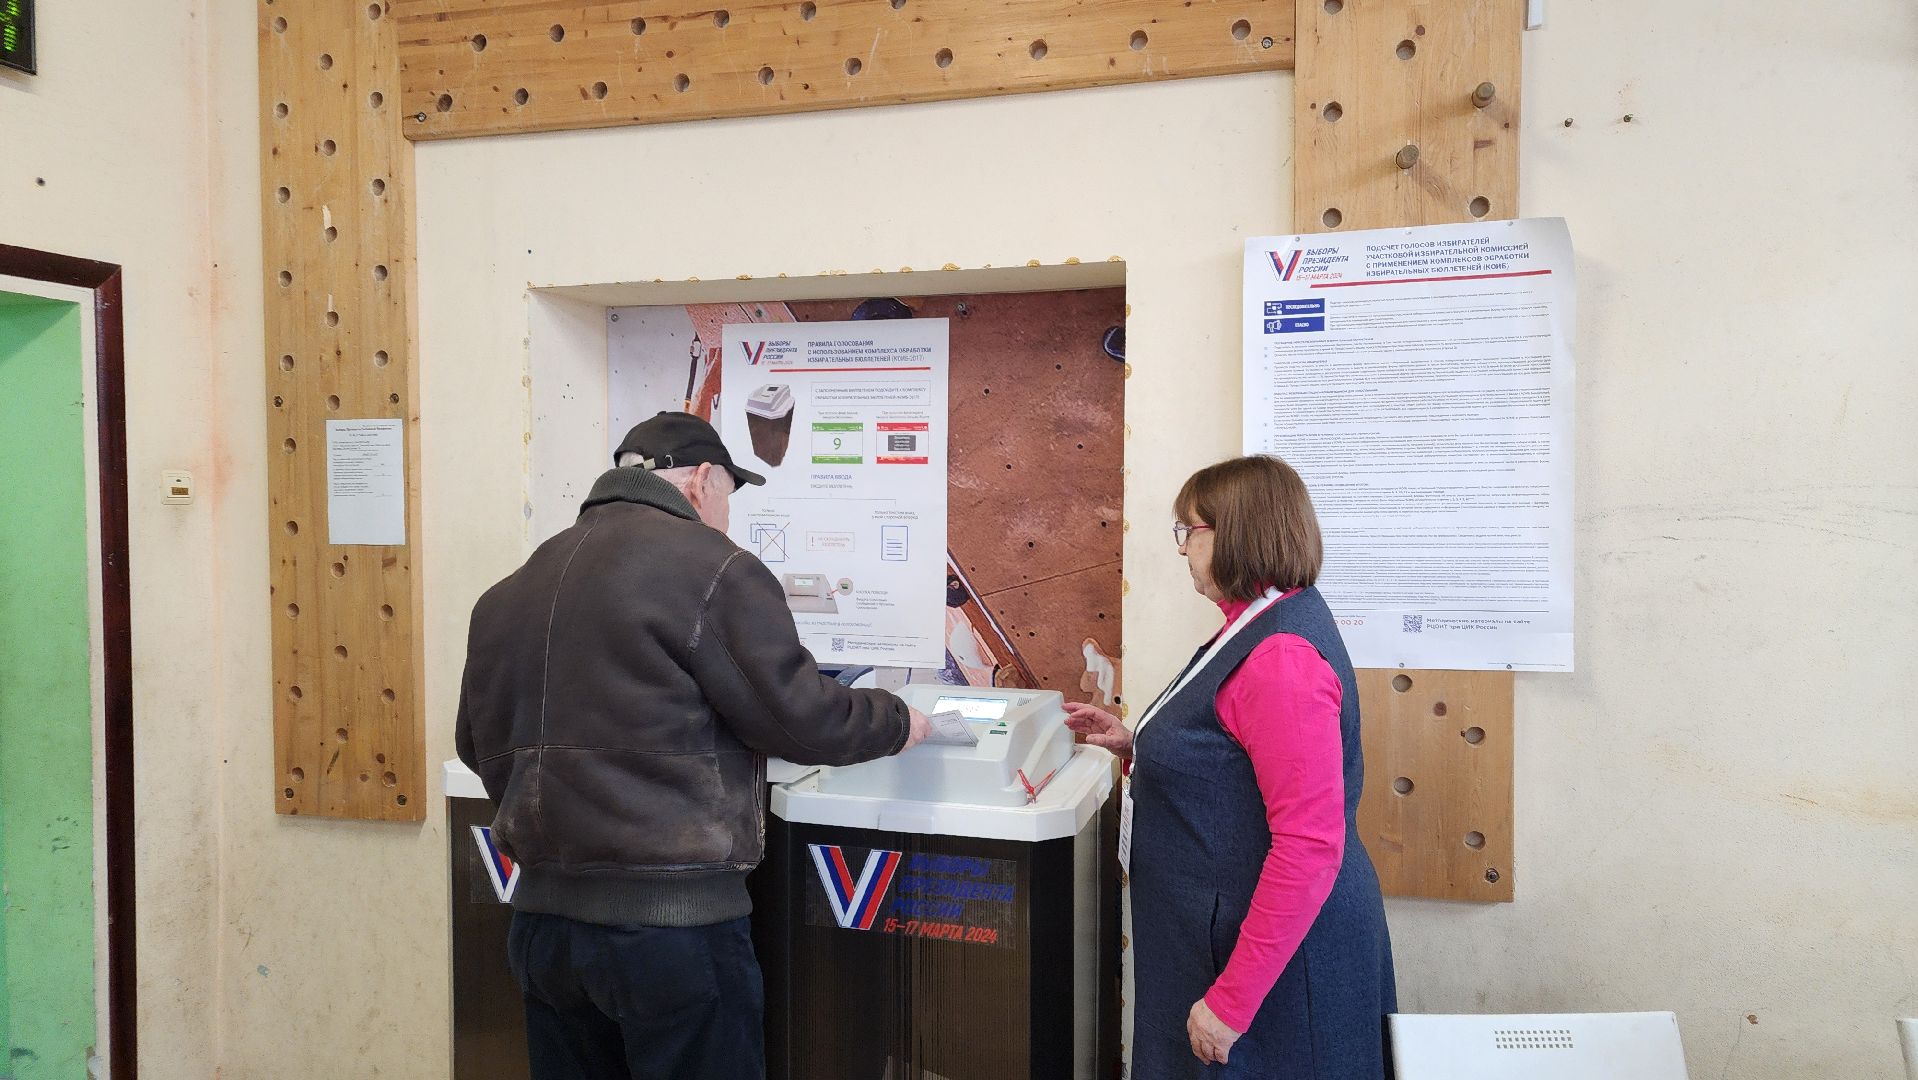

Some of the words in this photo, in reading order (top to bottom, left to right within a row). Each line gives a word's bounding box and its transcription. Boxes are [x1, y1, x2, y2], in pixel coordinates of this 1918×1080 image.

[1306, 247, 1340, 256] ВЫБОРЫ
[1366, 244, 1399, 252] ПОДСЧЕТ
[1400, 241, 1436, 250] ГОЛОСОВ
[1437, 237, 1490, 247] ИЗБИРАТЕЛЕЙ
[1366, 250, 1414, 260] УЧАСТКОВОЙ
[1415, 246, 1479, 257] ИЗБИРАТЕЛЬНОЙ
[1480, 243, 1529, 253] КОМИССИЕЙ
[1302, 255, 1350, 265] ПРЕЗИДЕНТА
[1372, 259, 1429, 269] ПРИМЕНЕНИЕМ
[1429, 256, 1483, 265] КОМПЛЕКСОВ
[1483, 253, 1530, 262] ОБРАБОТКИ
[1298, 265, 1329, 273] РОССИИ
[1366, 267, 1429, 277] ИЗБИРАТЕЛЬНЫХ
[1431, 263, 1481, 273] БЮЛЛЕТЕНЕЙ
[1483, 262, 1510, 271] (КОИБ)
[833, 437, 842, 450] 9
[898, 875, 1015, 903] ПРЕЗИДЕНТА
[919, 921, 964, 941] МАРТА
[965, 926, 999, 944] 2024
